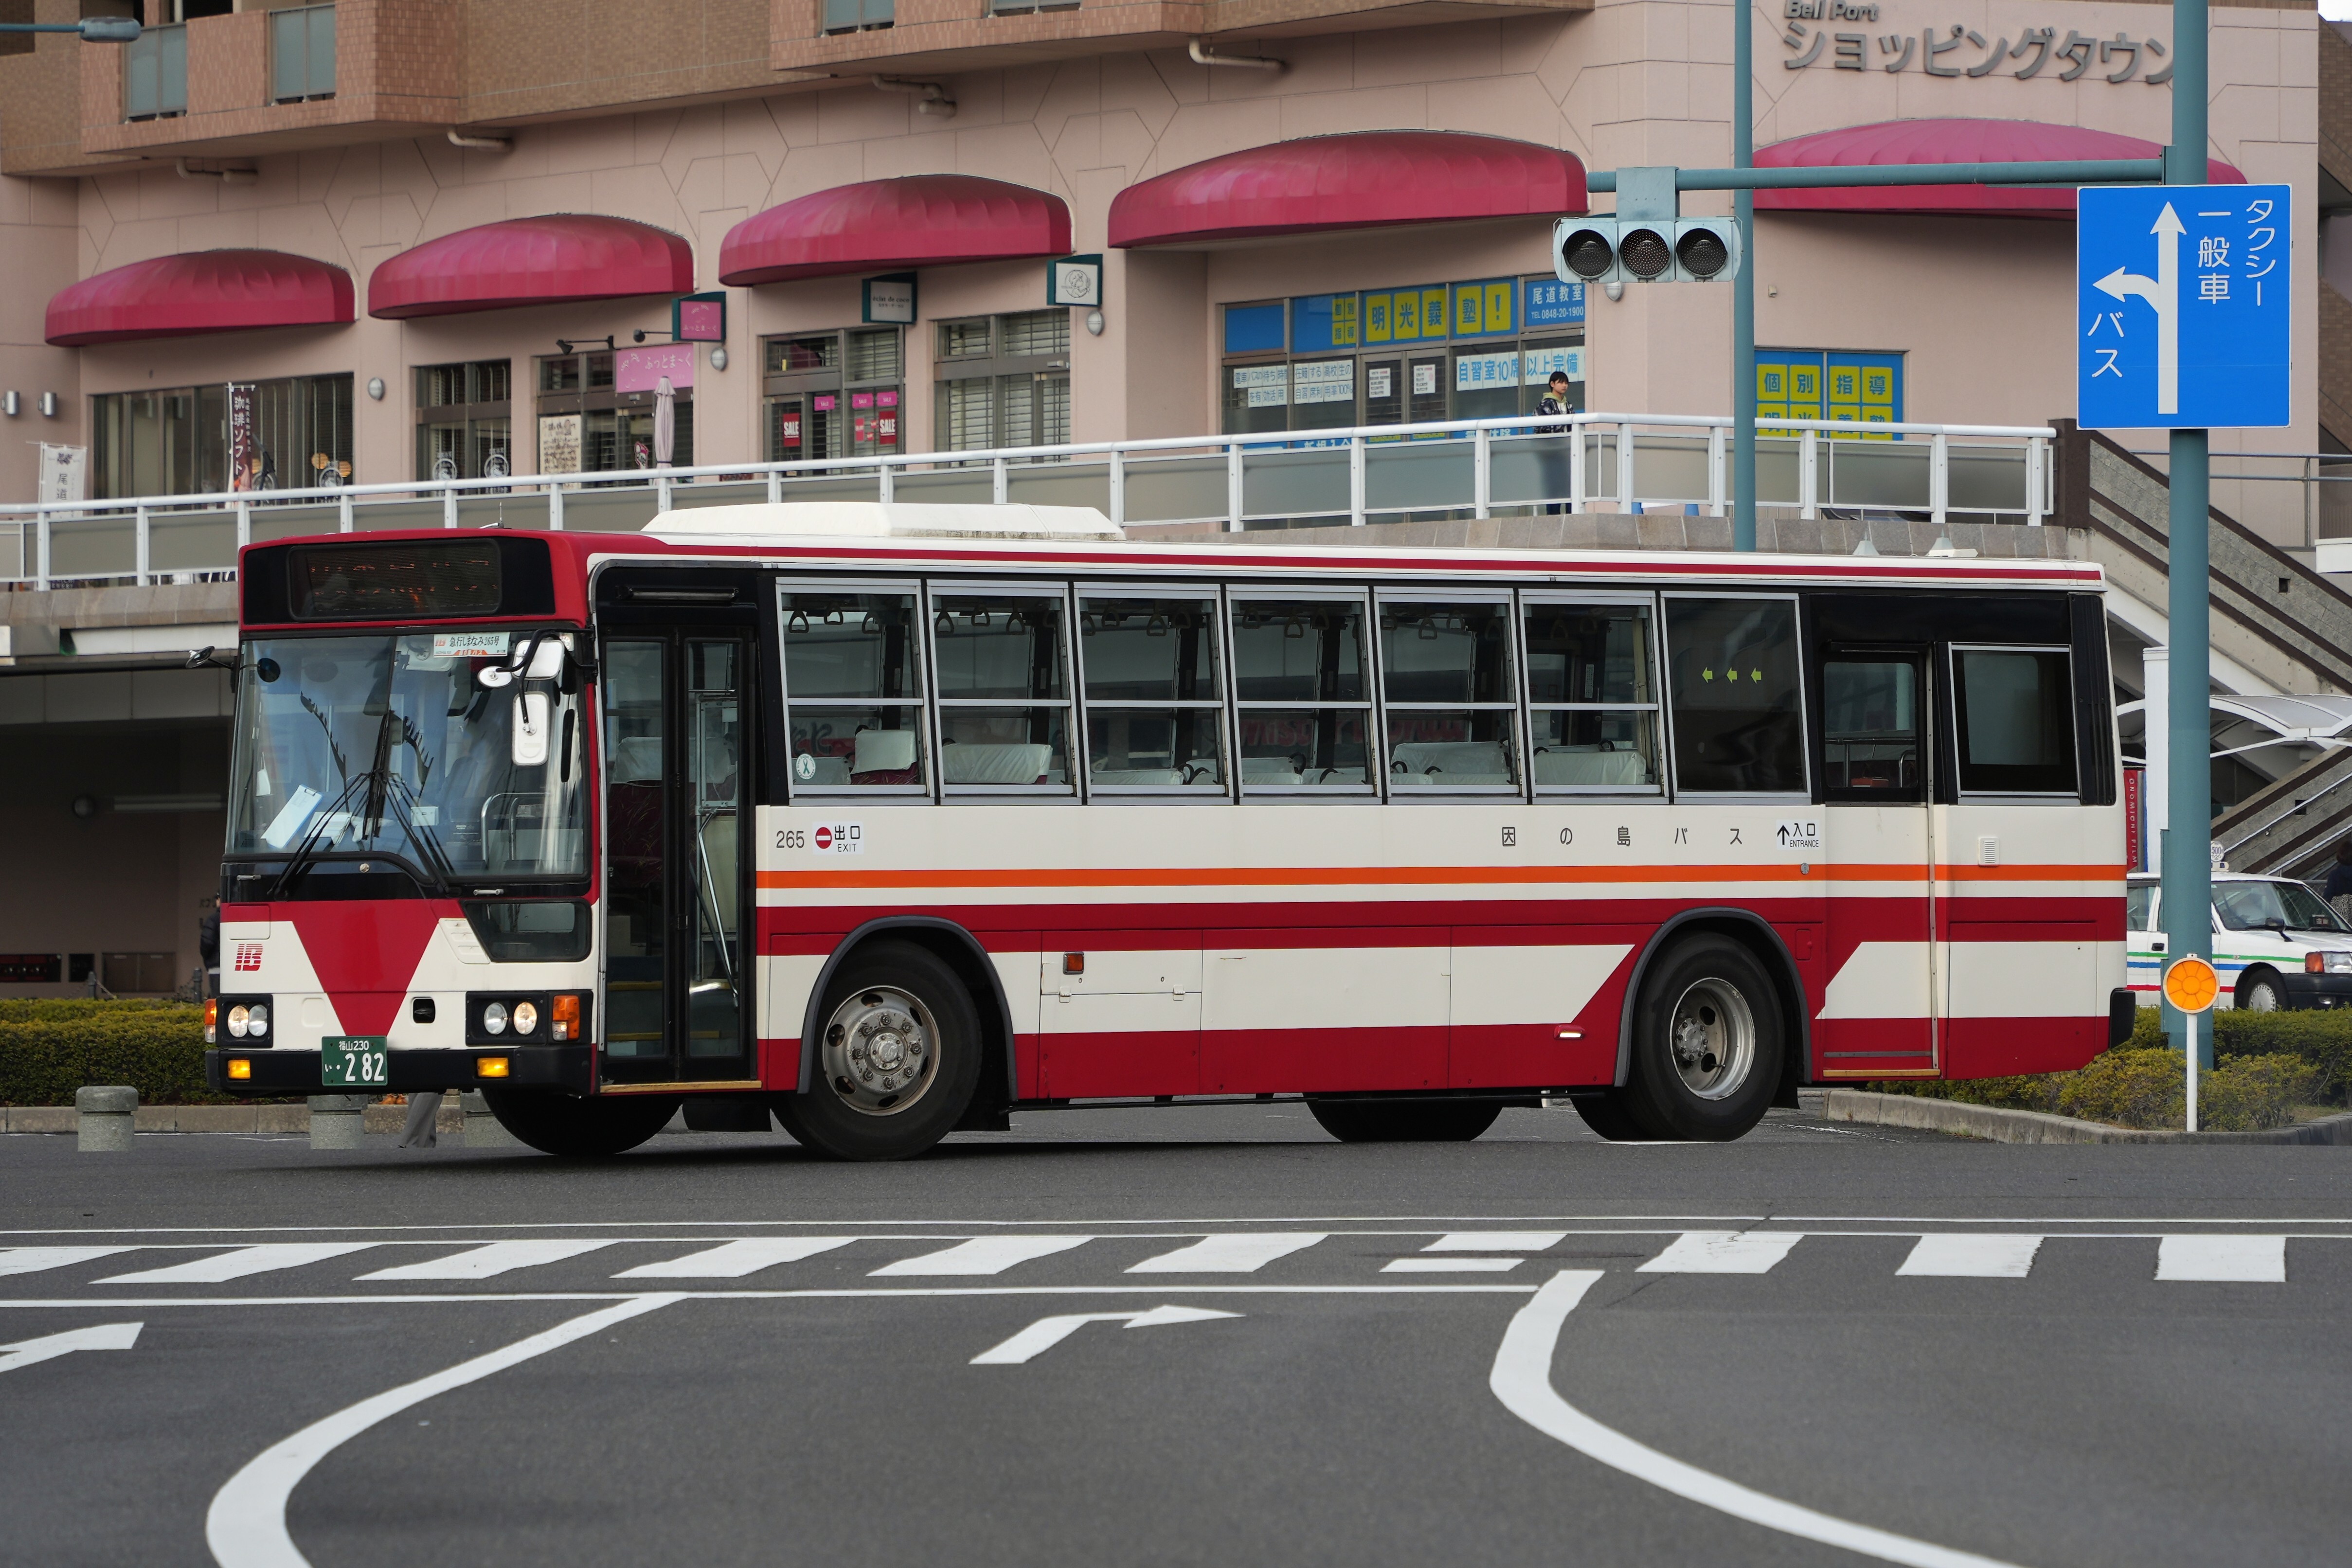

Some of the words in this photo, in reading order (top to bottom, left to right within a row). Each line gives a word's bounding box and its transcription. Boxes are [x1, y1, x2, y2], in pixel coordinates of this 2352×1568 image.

[1784, 0, 1824, 18] Bell
[1830, 0, 1879, 21] Port
[1784, 22, 2173, 83] ショッピングタウン
[2198, 212, 2231, 304] 一般車
[2246, 200, 2276, 306] タクシー
[1532, 284, 1582, 305] 尾道教室
[1542, 306, 1584, 319] 0848-20-1900
[2087, 312, 2124, 378] バス
[1764, 373, 1886, 395] 個別指導
[784, 421, 799, 436] SALE
[880, 419, 896, 434] SALE
[56, 473, 68, 500] 尾道
[449, 636, 500, 647] 急行しまなみ265号
[776, 830, 805, 849] 265
[834, 825, 861, 840] 出口
[1502, 826, 1742, 847] 因の島バス
[1793, 823, 1815, 837] 入口
[837, 843, 857, 852] EXIT
[1790, 839, 1819, 848] ENTRANCE
[338, 1040, 369, 1051] 福山230
